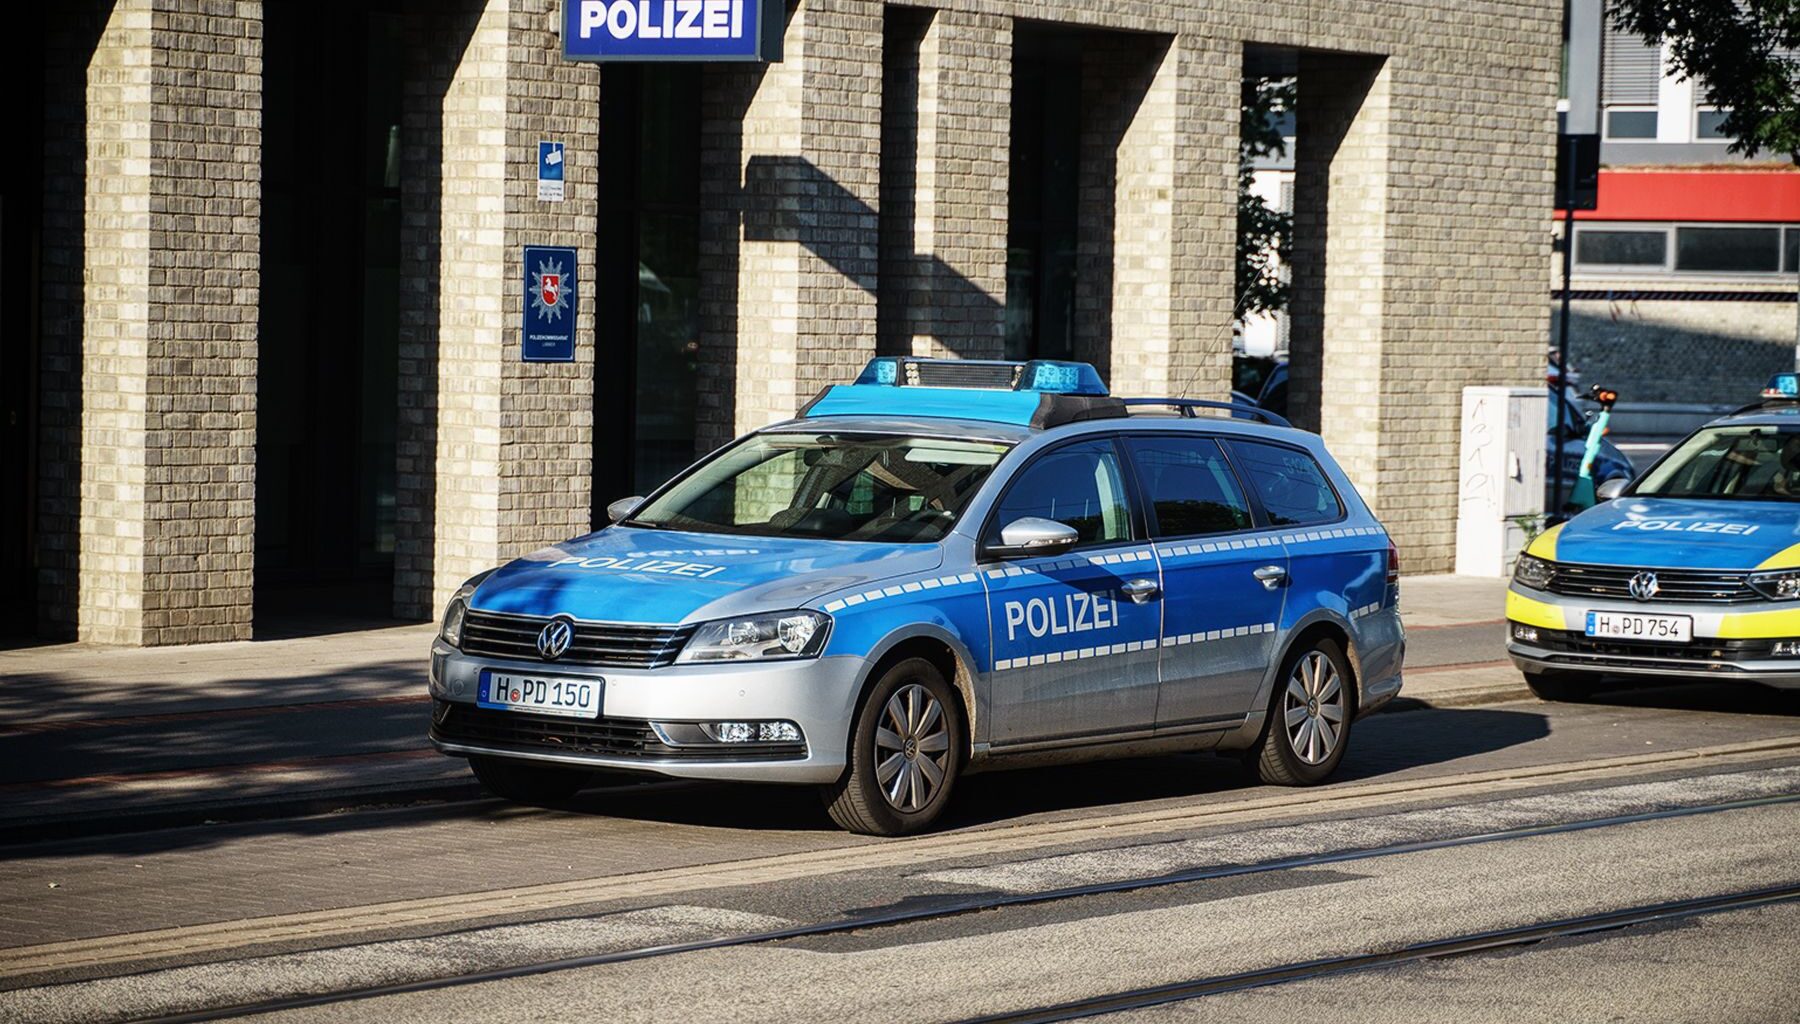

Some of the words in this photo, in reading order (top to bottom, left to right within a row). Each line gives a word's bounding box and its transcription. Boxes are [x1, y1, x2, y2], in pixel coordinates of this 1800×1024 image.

[580, 0, 743, 39] POLIZEI
[1611, 520, 1760, 536] POLIZEI
[547, 556, 726, 578] POLIZEI
[1005, 589, 1118, 641] POLIZEI
[1599, 616, 1610, 633] H
[1622, 617, 1643, 636] PD
[1648, 619, 1679, 638] 754
[537, 620, 571, 659] VW
[496, 676, 510, 701] H
[522, 679, 547, 704] PD
[551, 682, 591, 708] 150
